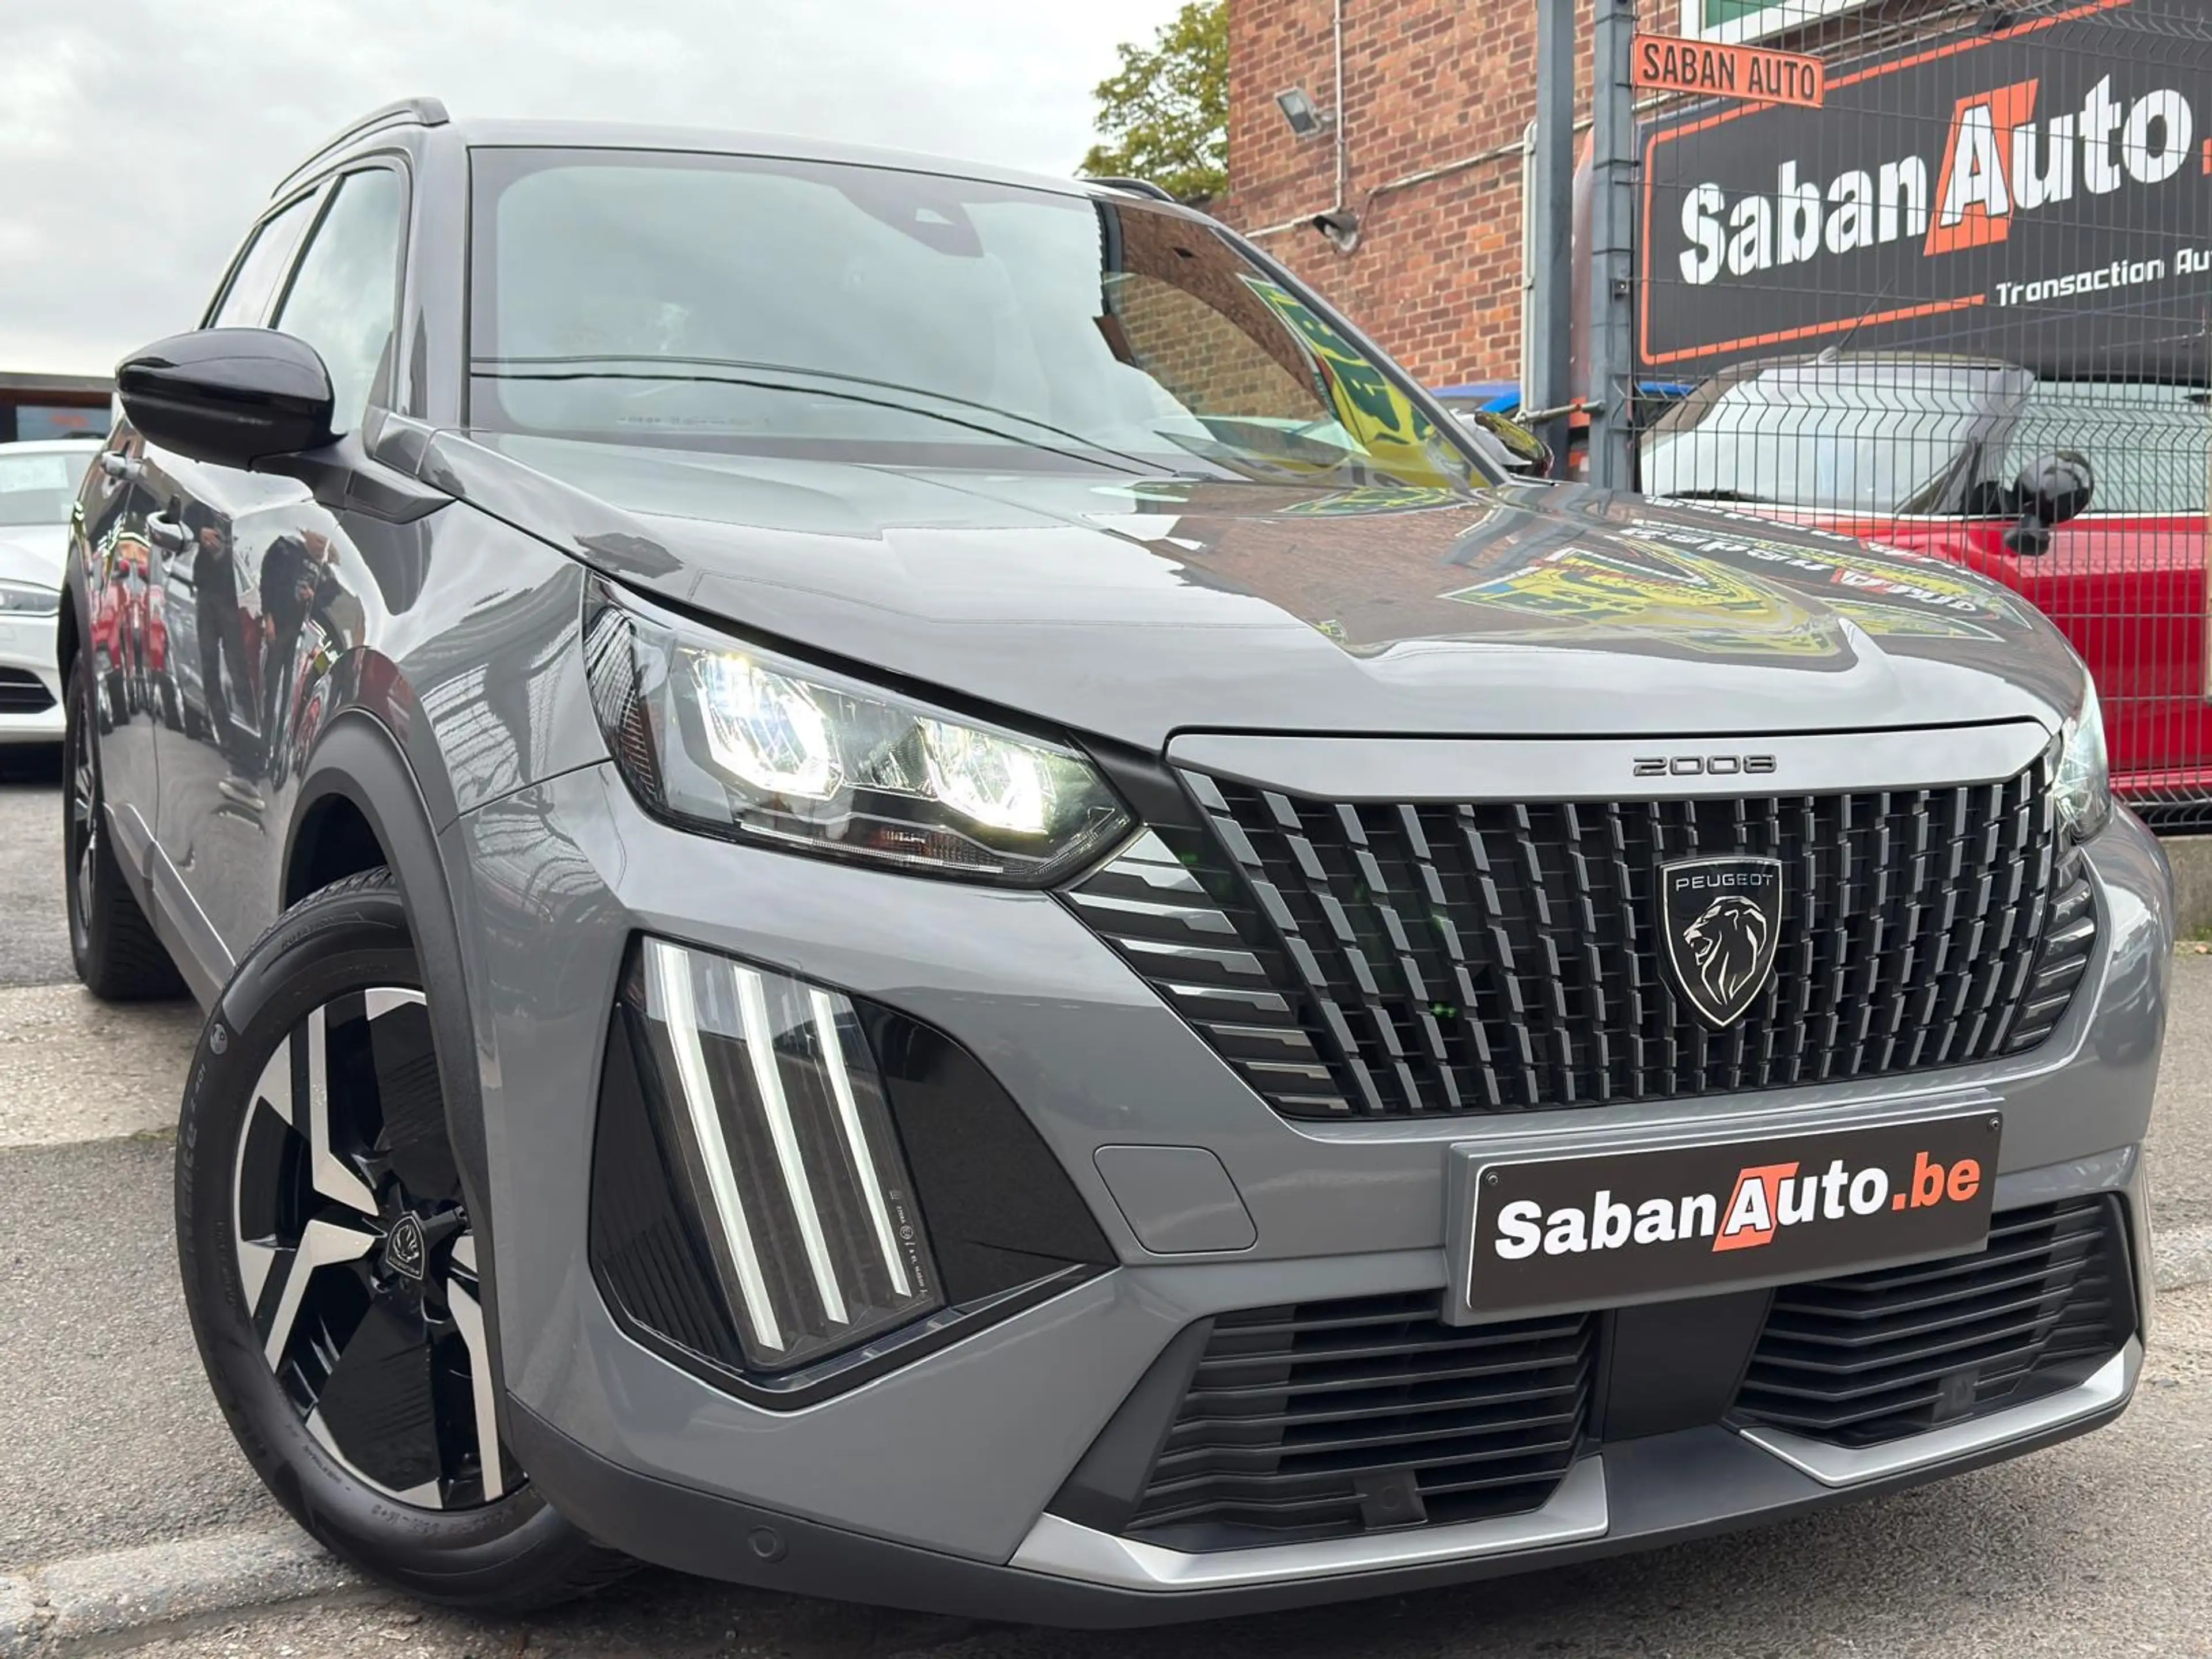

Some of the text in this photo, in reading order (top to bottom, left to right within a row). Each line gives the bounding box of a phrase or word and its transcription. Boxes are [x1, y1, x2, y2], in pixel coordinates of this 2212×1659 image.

[1643, 43, 1815, 100] SABAN AUTO
[1996, 247, 2212, 307] Transaction Au
[1633, 754, 1778, 777] 2008
[1675, 873, 1774, 892] PEUGEOT
[1494, 1151, 1982, 1261] SabanAuto.be
